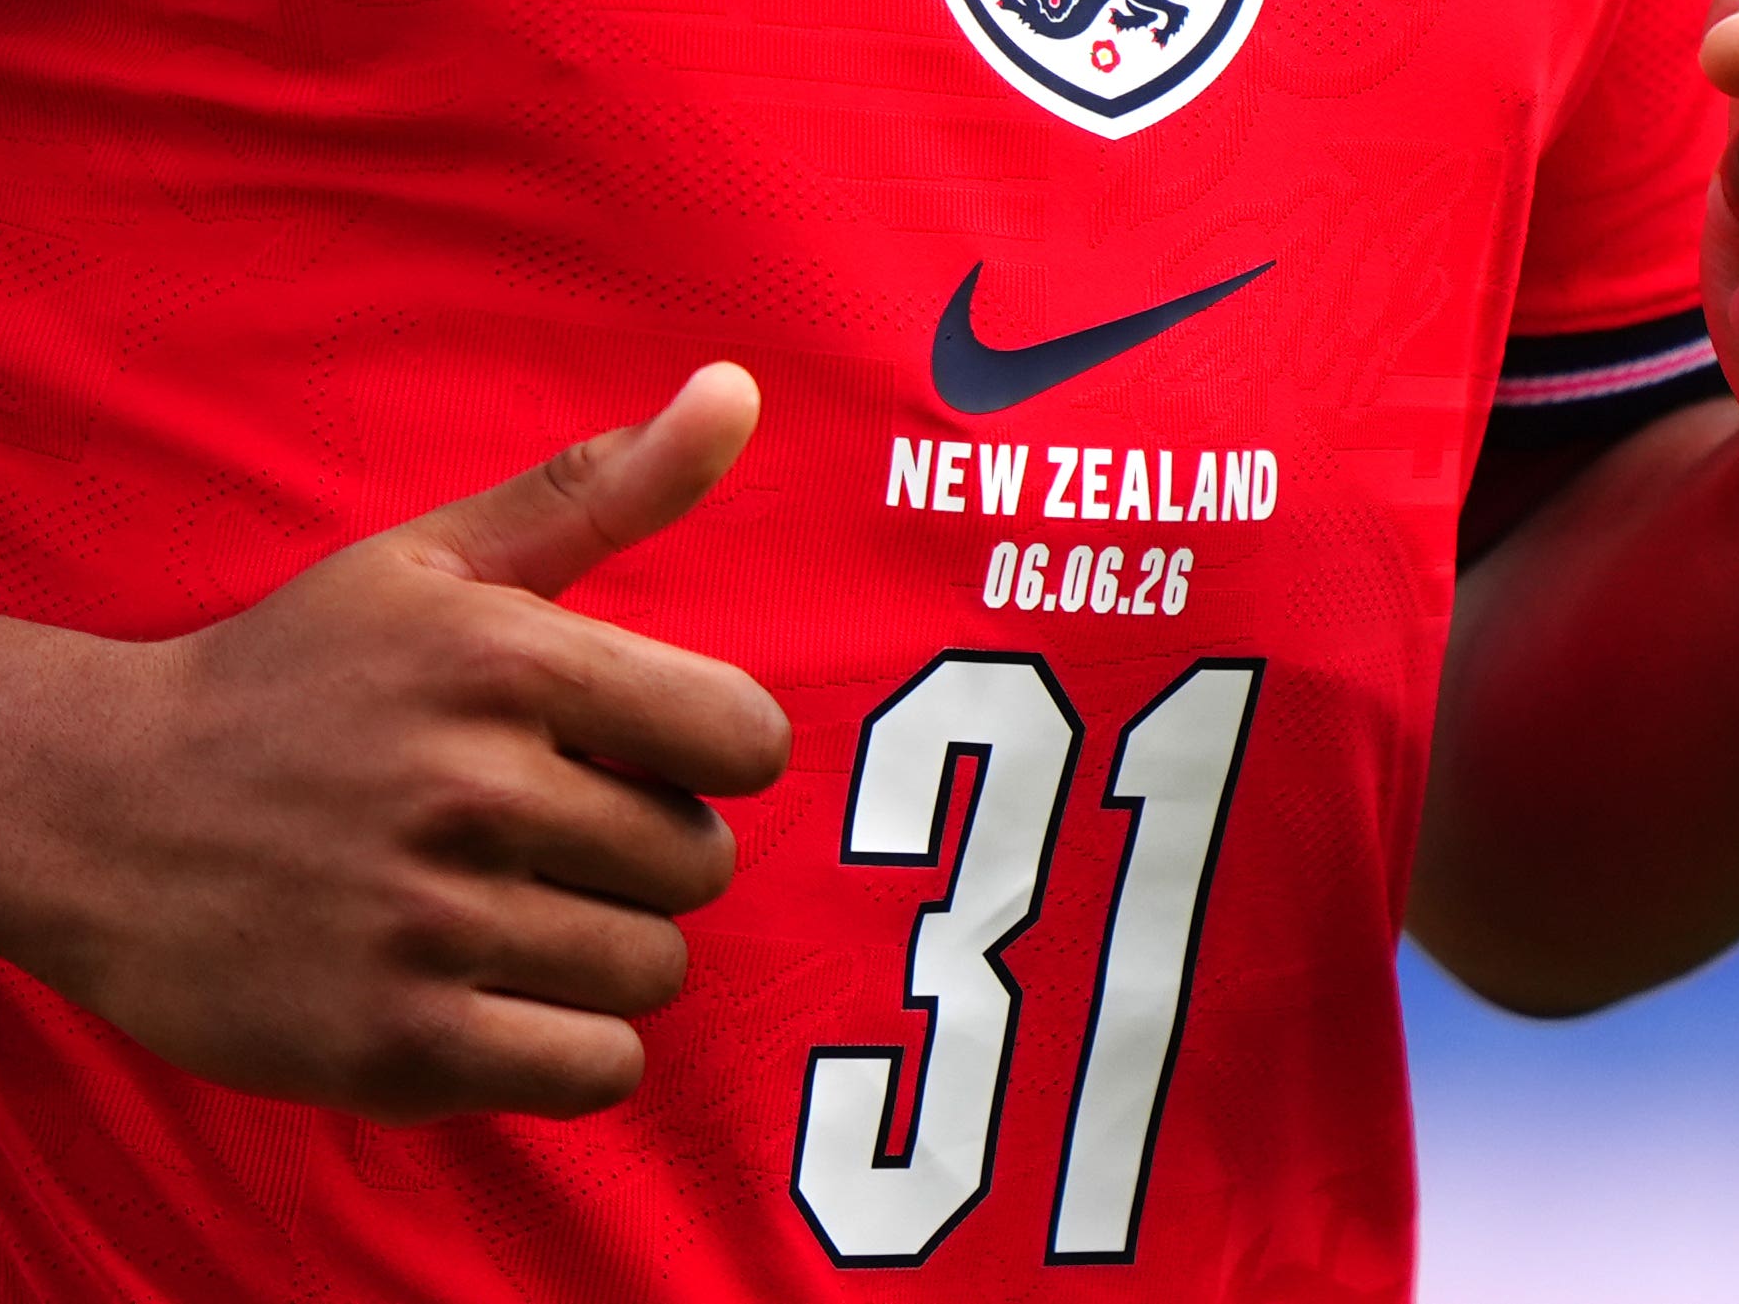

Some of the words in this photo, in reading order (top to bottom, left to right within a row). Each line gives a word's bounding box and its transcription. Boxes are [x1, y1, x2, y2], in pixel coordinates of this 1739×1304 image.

[885, 436, 1029, 516] NEW
[1043, 446, 1279, 522] ZEALAND
[982, 541, 1195, 616] 06.06.26
[789, 647, 1267, 1269] 31
